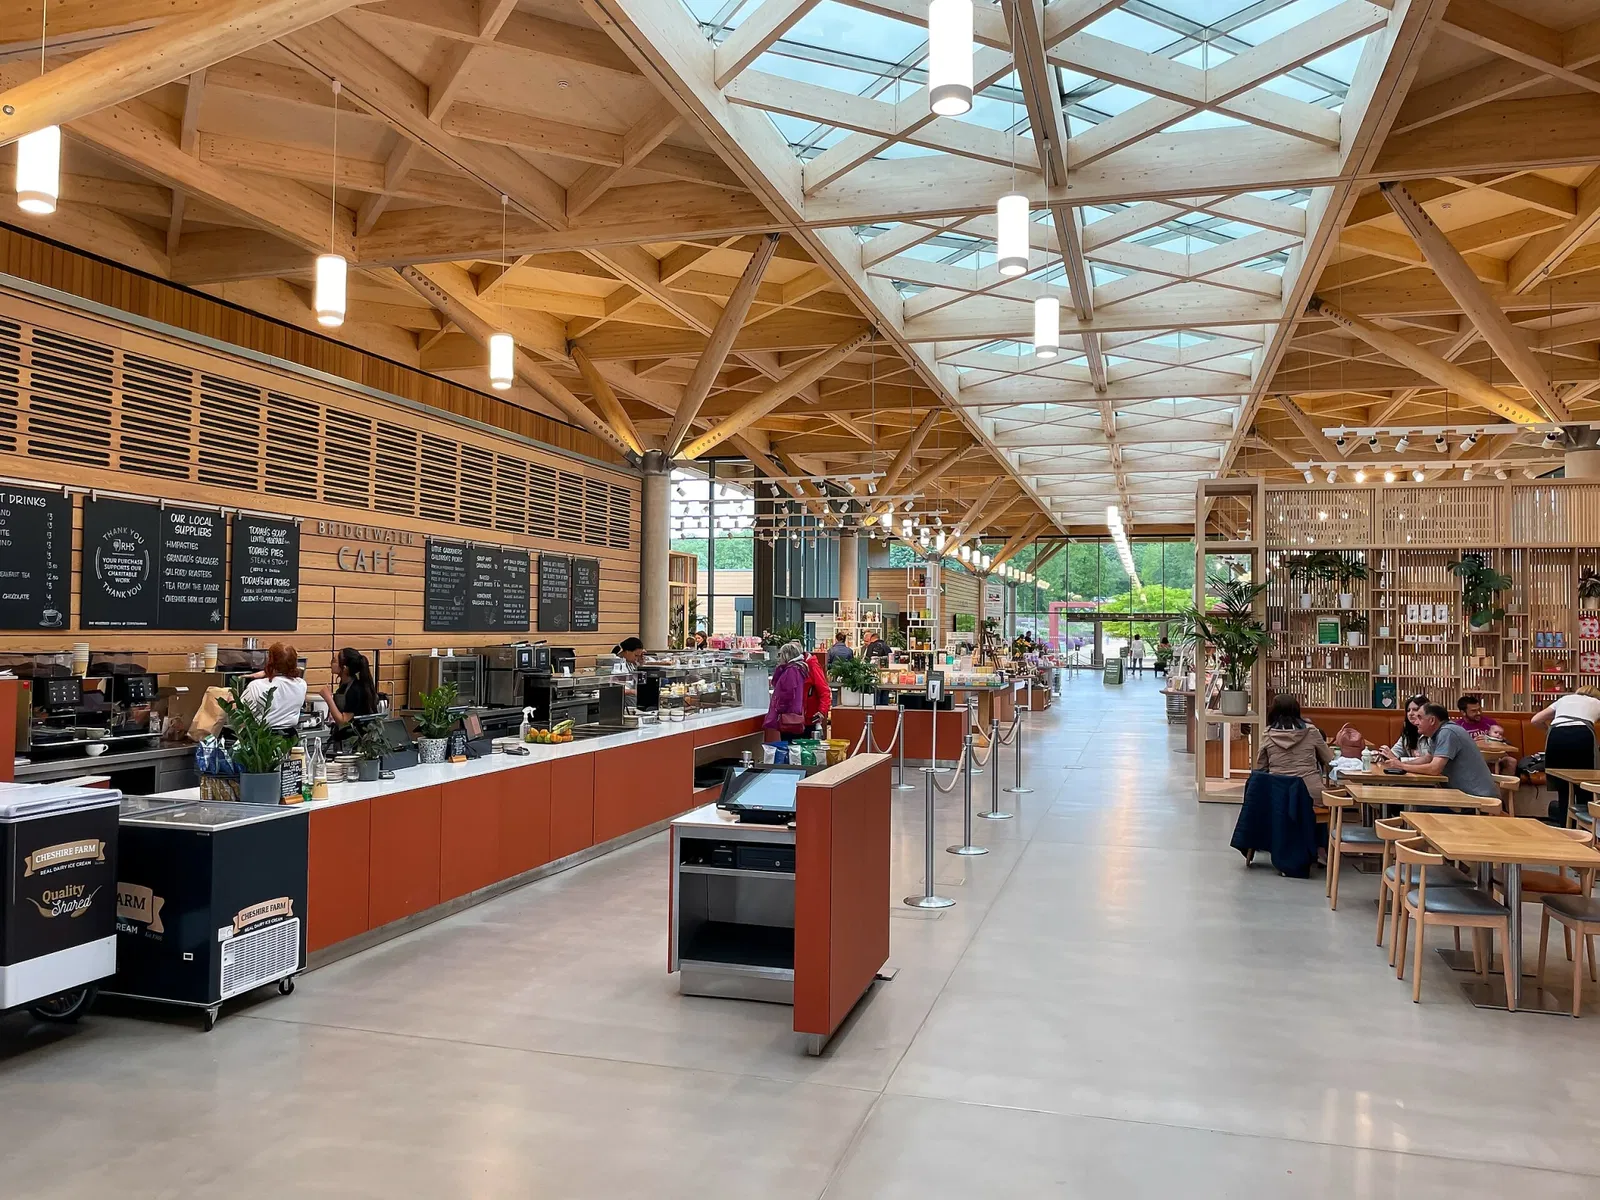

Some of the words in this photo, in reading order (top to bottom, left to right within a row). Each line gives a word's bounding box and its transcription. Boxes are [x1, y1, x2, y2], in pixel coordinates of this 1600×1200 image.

[9, 494, 47, 507] DRINKS
[170, 513, 186, 524] OUR
[189, 515, 214, 527] LOCAL
[102, 527, 128, 541] THANK
[130, 529, 145, 545] YOU
[174, 525, 212, 538] SUPPLIERS
[249, 525, 271, 537] TODAY'S
[271, 528, 287, 538] SOUP
[318, 521, 414, 544] BRIDGEWATER
[121, 542, 135, 552] RHS
[248, 545, 269, 557] TODAY'S
[270, 548, 284, 558] PIES
[117, 558, 143, 566] PURCHASE
[250, 556, 267, 565] STEAK
[271, 559, 289, 567] STOUT
[337, 545, 396, 574] CAFÉ
[107, 570, 138, 578] CHARITABLE
[164, 581, 176, 590] TEA
[177, 582, 191, 590] FROM
[240, 575, 264, 586] TODAY'S
[264, 577, 274, 586] HOT
[273, 578, 291, 587] DISHES
[102, 581, 127, 599] THANK
[127, 583, 142, 597] YOU
[35, 847, 73, 863] CHESHIRE
[74, 844, 96, 855] FARM
[53, 864, 68, 872] DAIRY
[42, 884, 86, 904] Quality
[51, 894, 93, 917] Shared
[117, 892, 147, 910] ARM
[240, 906, 269, 922] CHESHIRE
[269, 901, 287, 912] FARM
[116, 922, 139, 934] REAM
